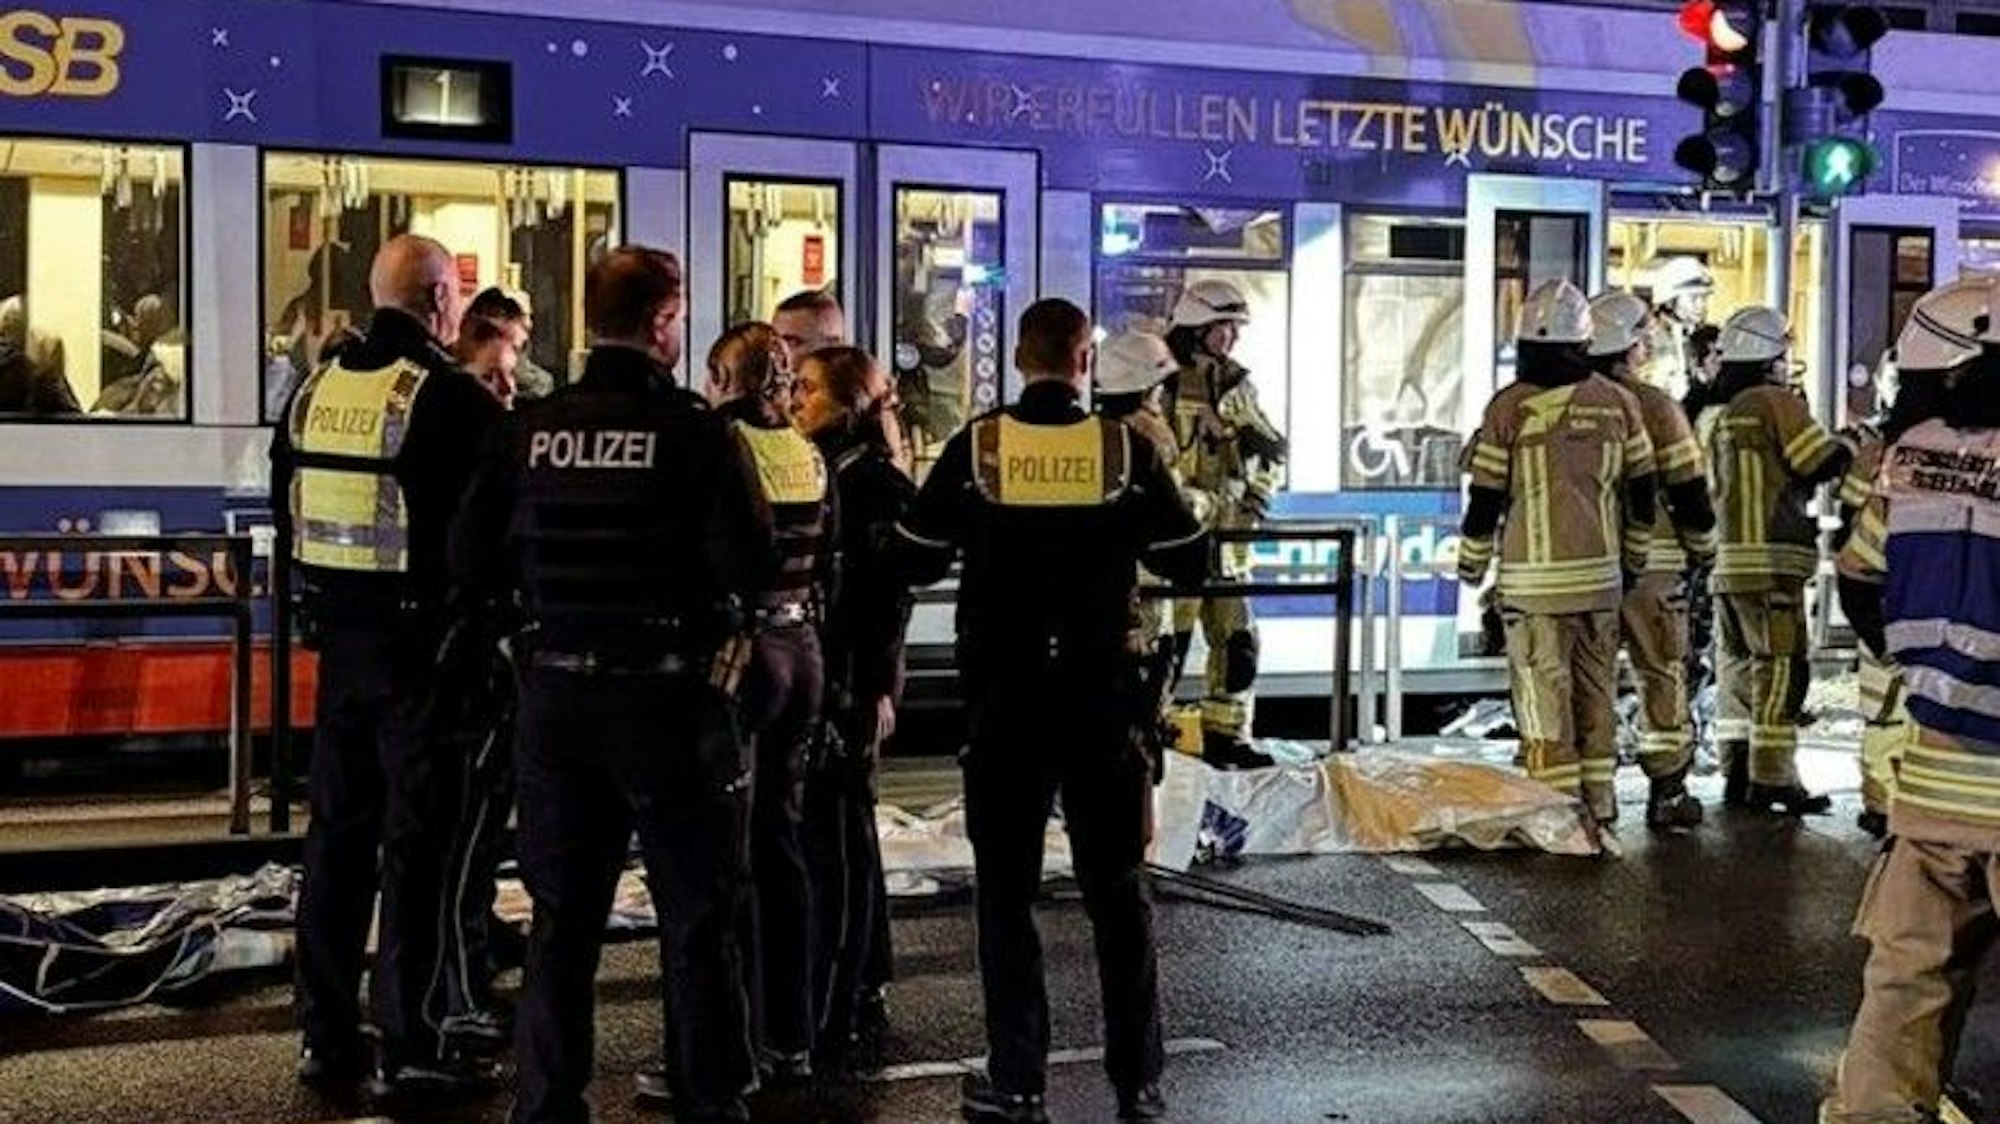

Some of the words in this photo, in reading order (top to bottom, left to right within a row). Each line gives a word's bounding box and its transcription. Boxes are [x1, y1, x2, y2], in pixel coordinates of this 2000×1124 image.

[436, 69, 450, 119] 1
[1273, 100, 1427, 153] LETZTE
[1436, 102, 1649, 164] WÜNSCHE
[309, 405, 379, 436] POLIZEI
[530, 431, 656, 469] POLIZEI
[1008, 457, 1096, 483] POLIZEI
